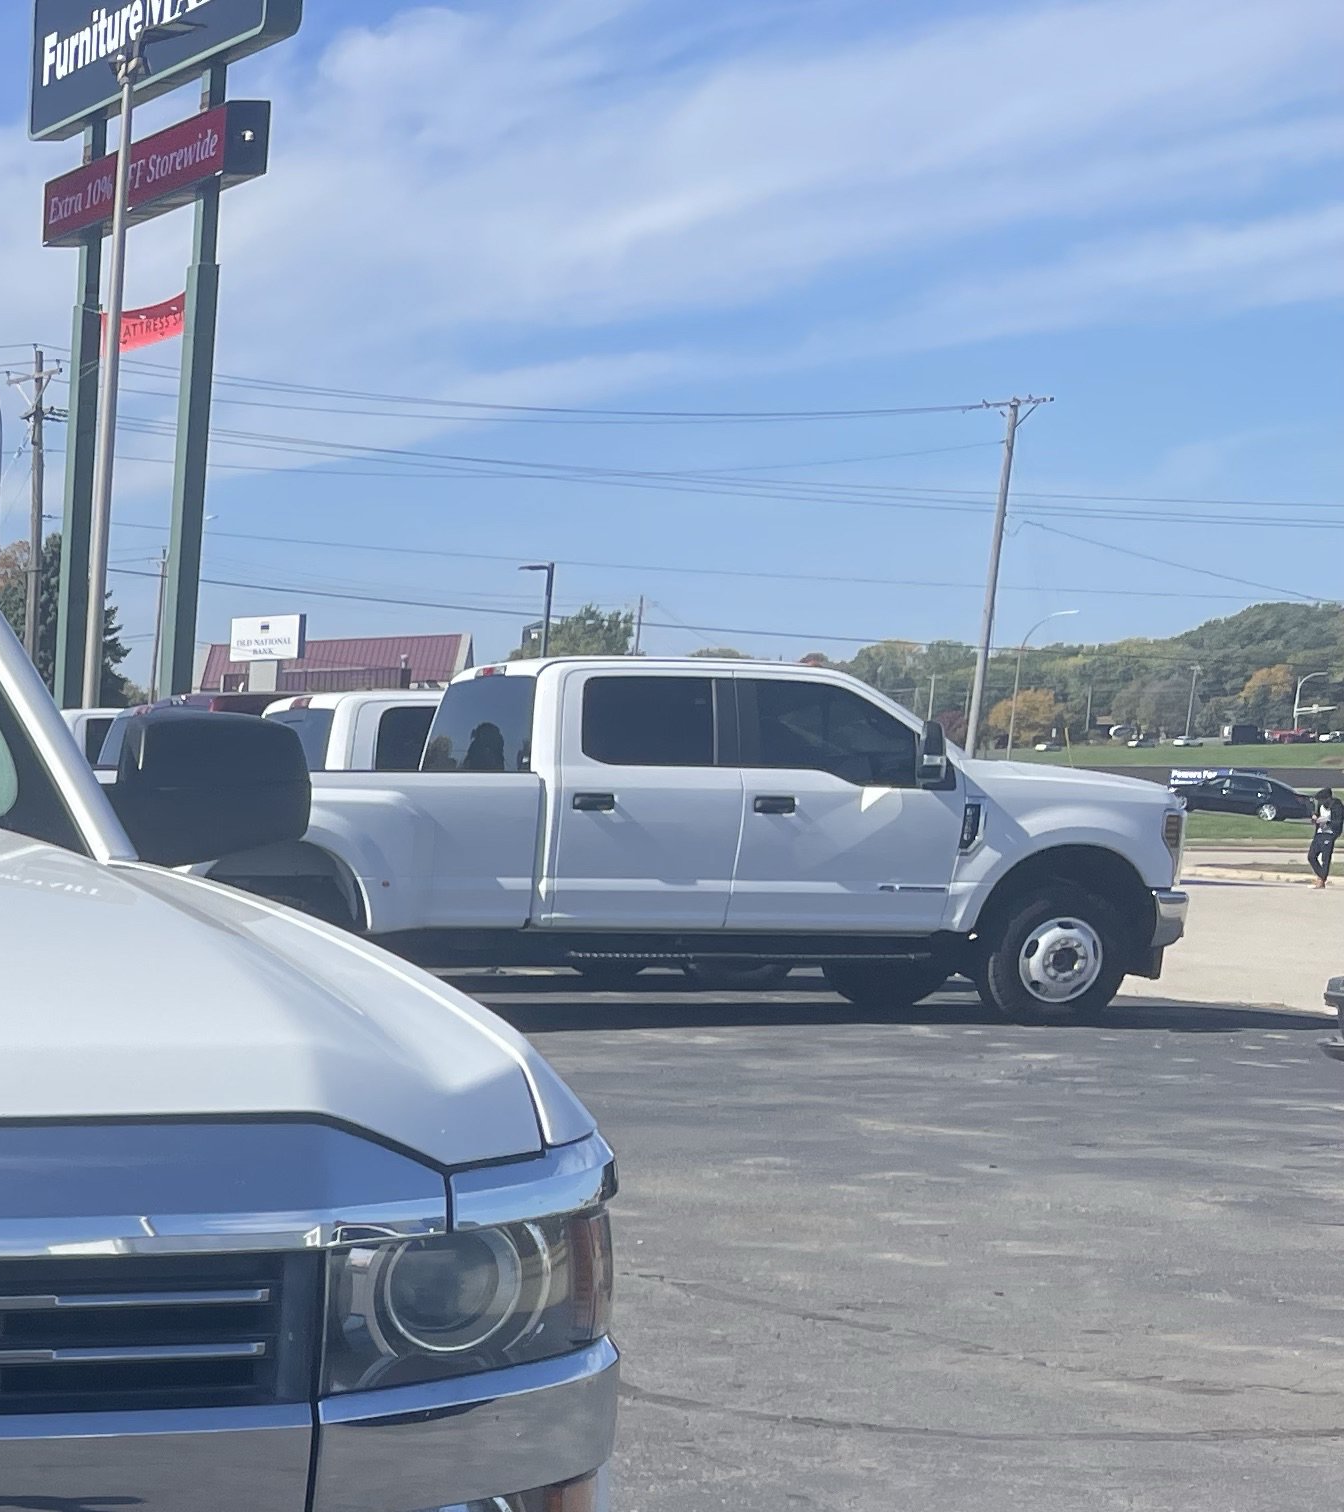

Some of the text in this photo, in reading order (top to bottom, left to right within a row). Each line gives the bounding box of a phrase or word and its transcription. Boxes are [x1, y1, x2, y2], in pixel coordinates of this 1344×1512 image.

[48, 192, 83, 225] Extra
[146, 128, 219, 184] Storewide
[123, 315, 170, 338] ATTRESS
[254, 637, 291, 647] NATIONAL
[252, 647, 274, 656] BANK
